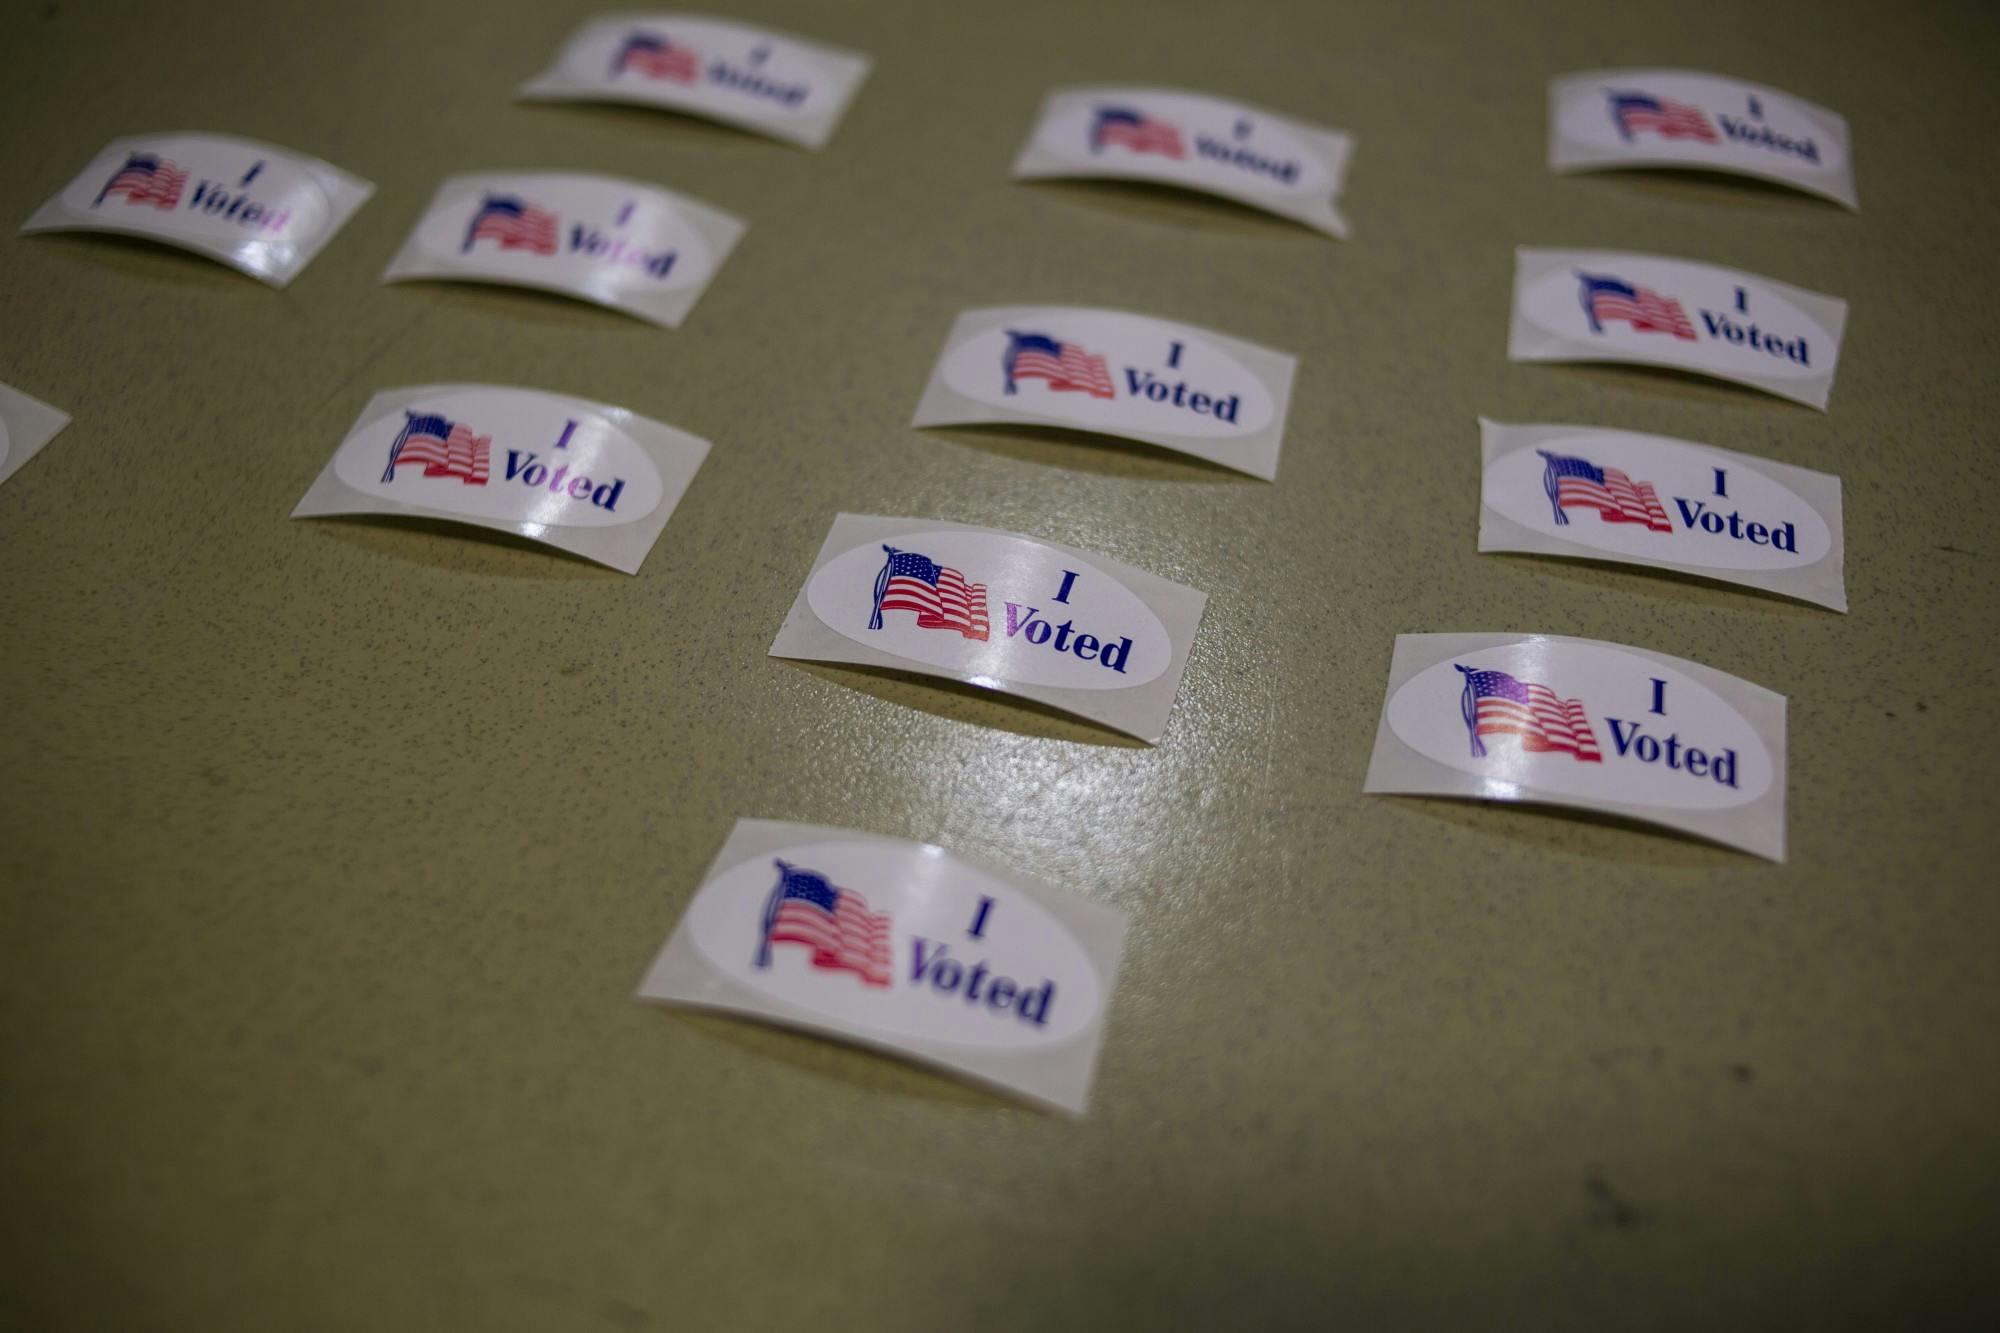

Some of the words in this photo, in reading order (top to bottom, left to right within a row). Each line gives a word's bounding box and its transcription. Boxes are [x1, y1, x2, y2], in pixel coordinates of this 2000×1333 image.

[239, 160, 264, 187] I
[1733, 286, 1749, 314] I
[1166, 342, 1185, 368] I
[1700, 310, 1811, 368] Voted
[1124, 368, 1241, 425] Voted
[555, 419, 578, 450] I
[504, 449, 626, 512] Voted
[1713, 469, 1729, 499] I
[1674, 497, 1799, 554] Voted
[1052, 569, 1080, 604] I
[1003, 602, 1133, 674] Voted
[1649, 678, 1667, 716] I
[1604, 717, 1739, 790] Voted
[967, 894, 997, 939] I
[908, 935, 1056, 1026] Voted
